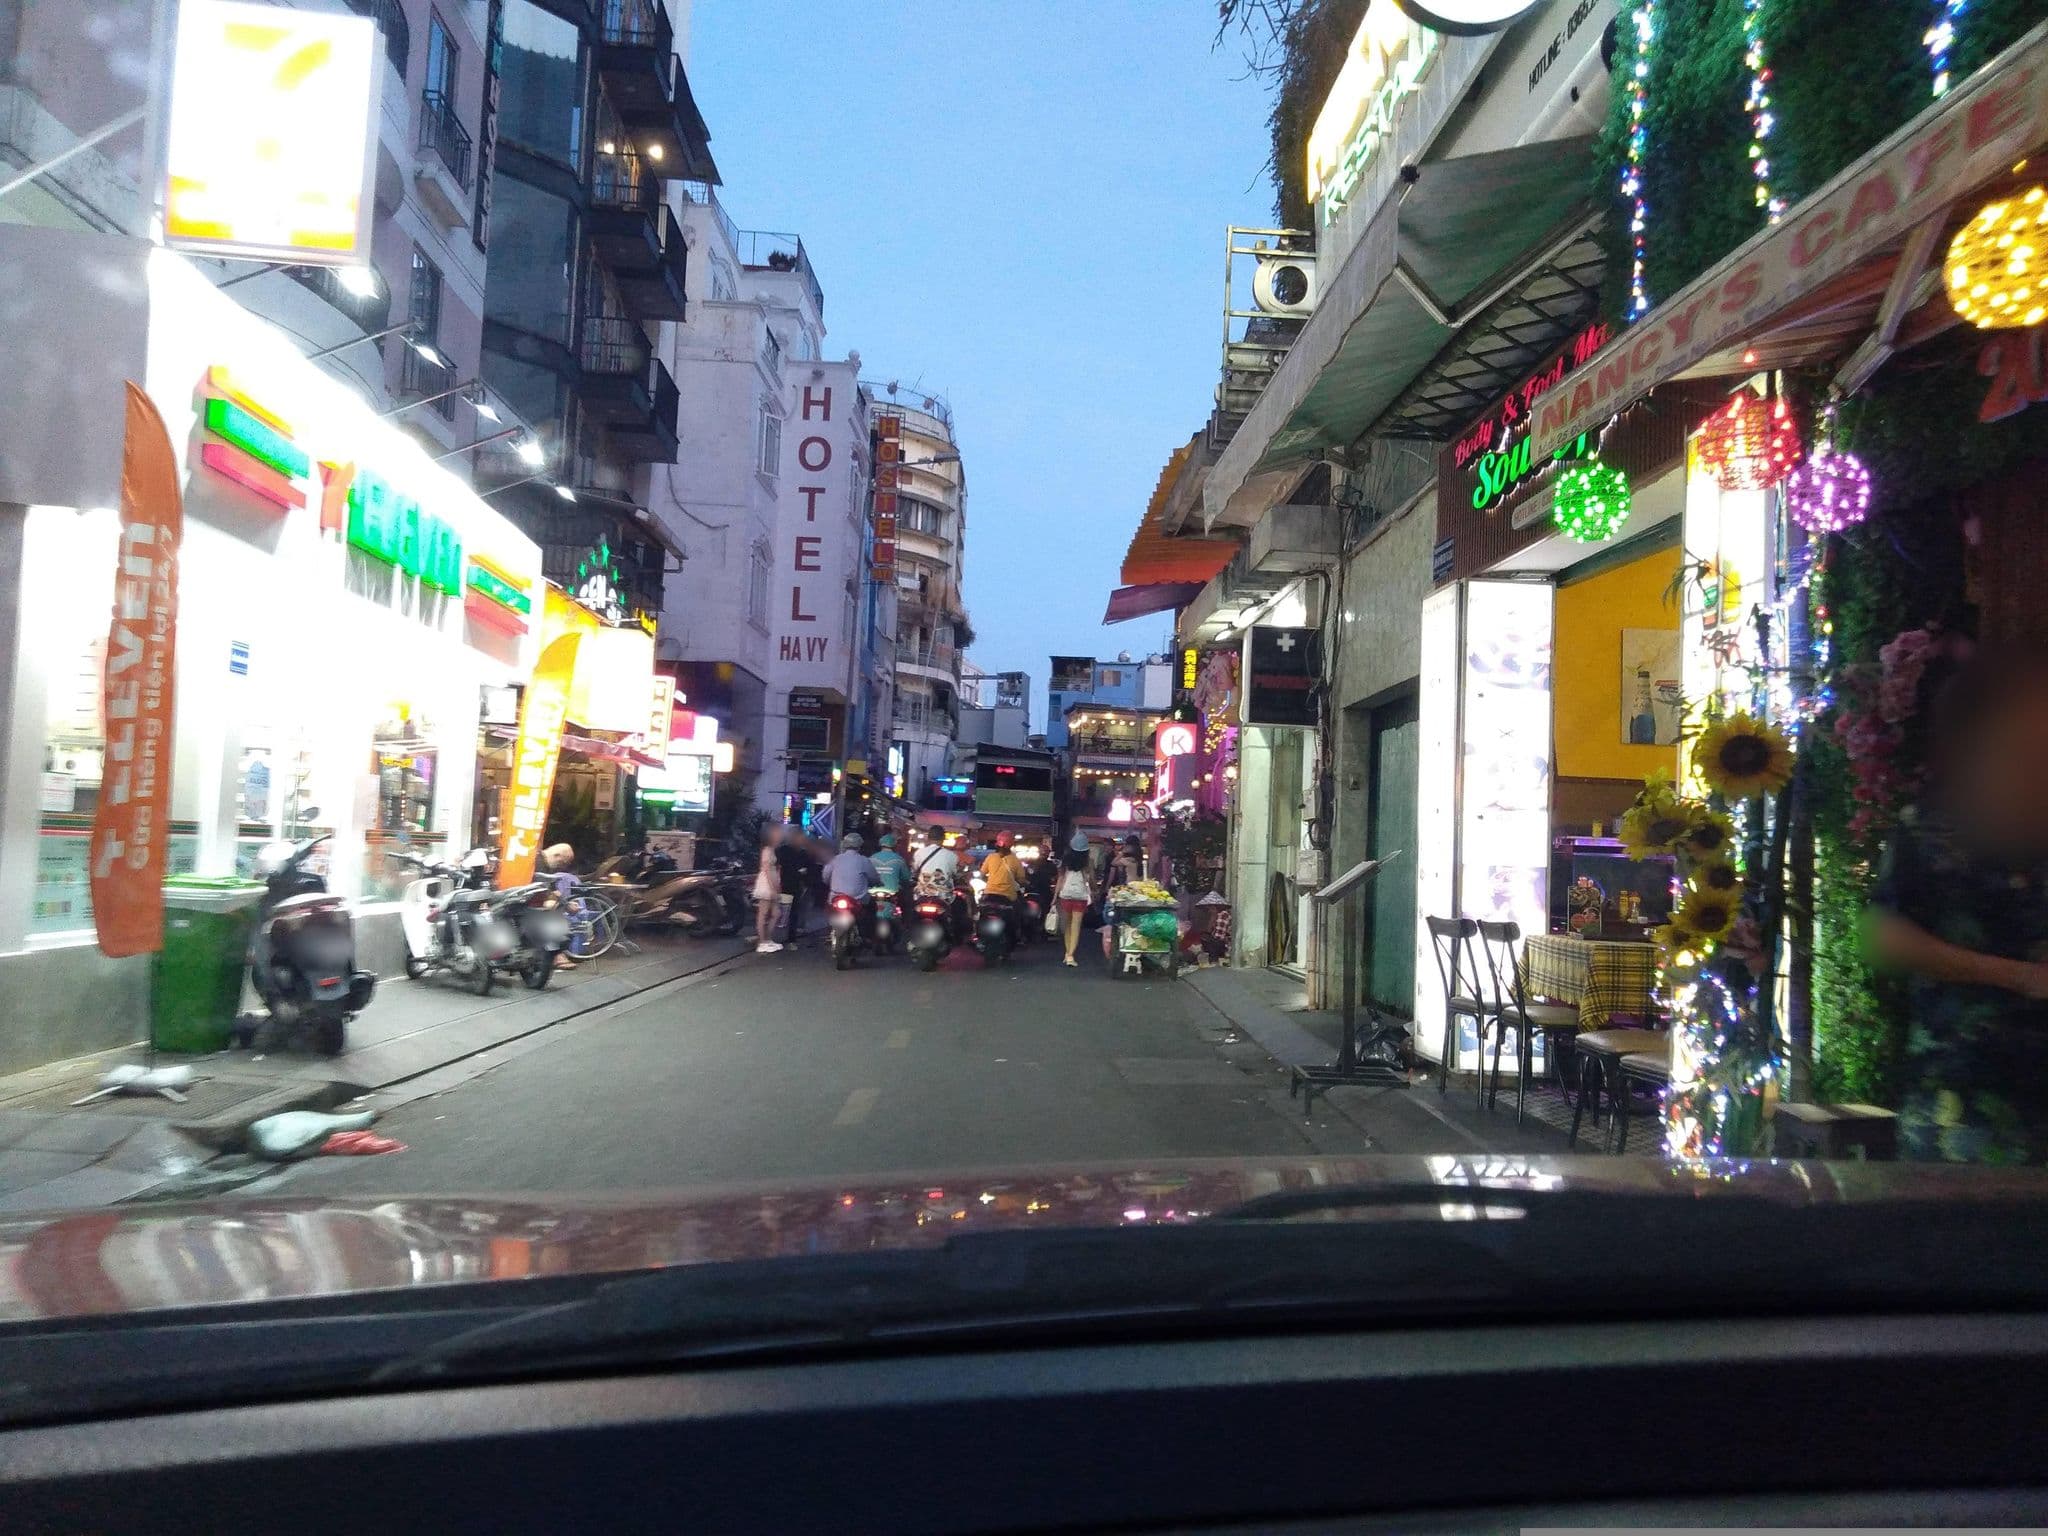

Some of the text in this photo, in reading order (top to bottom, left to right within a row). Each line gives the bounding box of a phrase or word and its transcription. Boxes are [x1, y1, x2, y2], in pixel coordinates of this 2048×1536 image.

[1528, 31, 1561, 95] HOTLINE
[1540, 68, 2032, 438] NANCY'S CAFE
[1455, 420, 1493, 470] Body
[1502, 394, 1518, 426] &
[792, 386, 832, 621] HOTEL
[876, 419, 897, 563] HOSTEL
[1170, 734, 1187, 753] K
